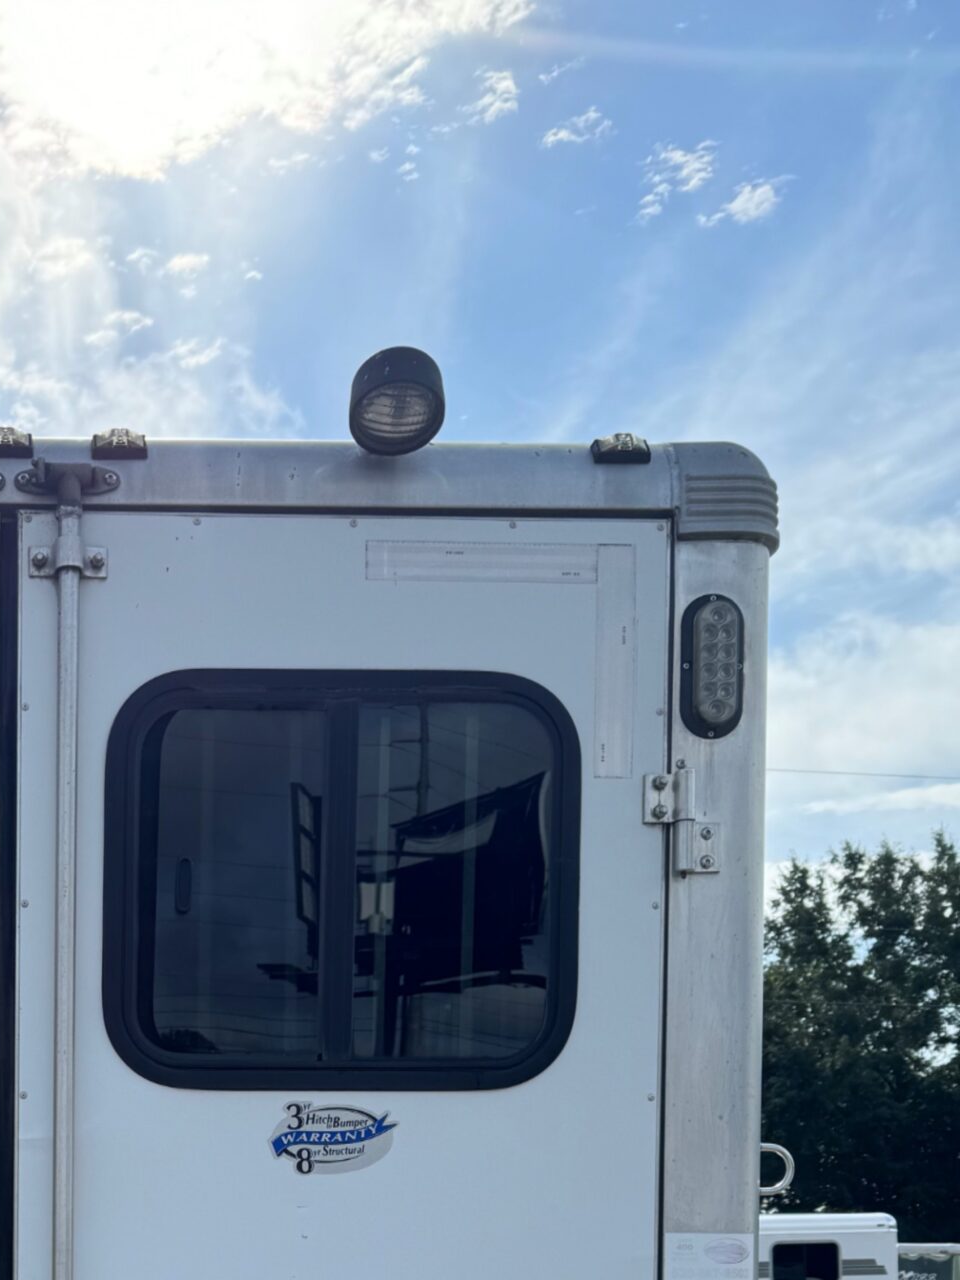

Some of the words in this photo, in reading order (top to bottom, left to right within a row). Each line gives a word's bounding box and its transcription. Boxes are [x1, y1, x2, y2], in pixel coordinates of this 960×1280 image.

[286, 1103, 303, 1130] 3
[305, 1112, 333, 1126] Hitch
[332, 1116, 368, 1129] Bumper
[281, 1123, 377, 1145] WARRANTY
[296, 1147, 313, 1174] 8
[322, 1144, 365, 1156] Structural
